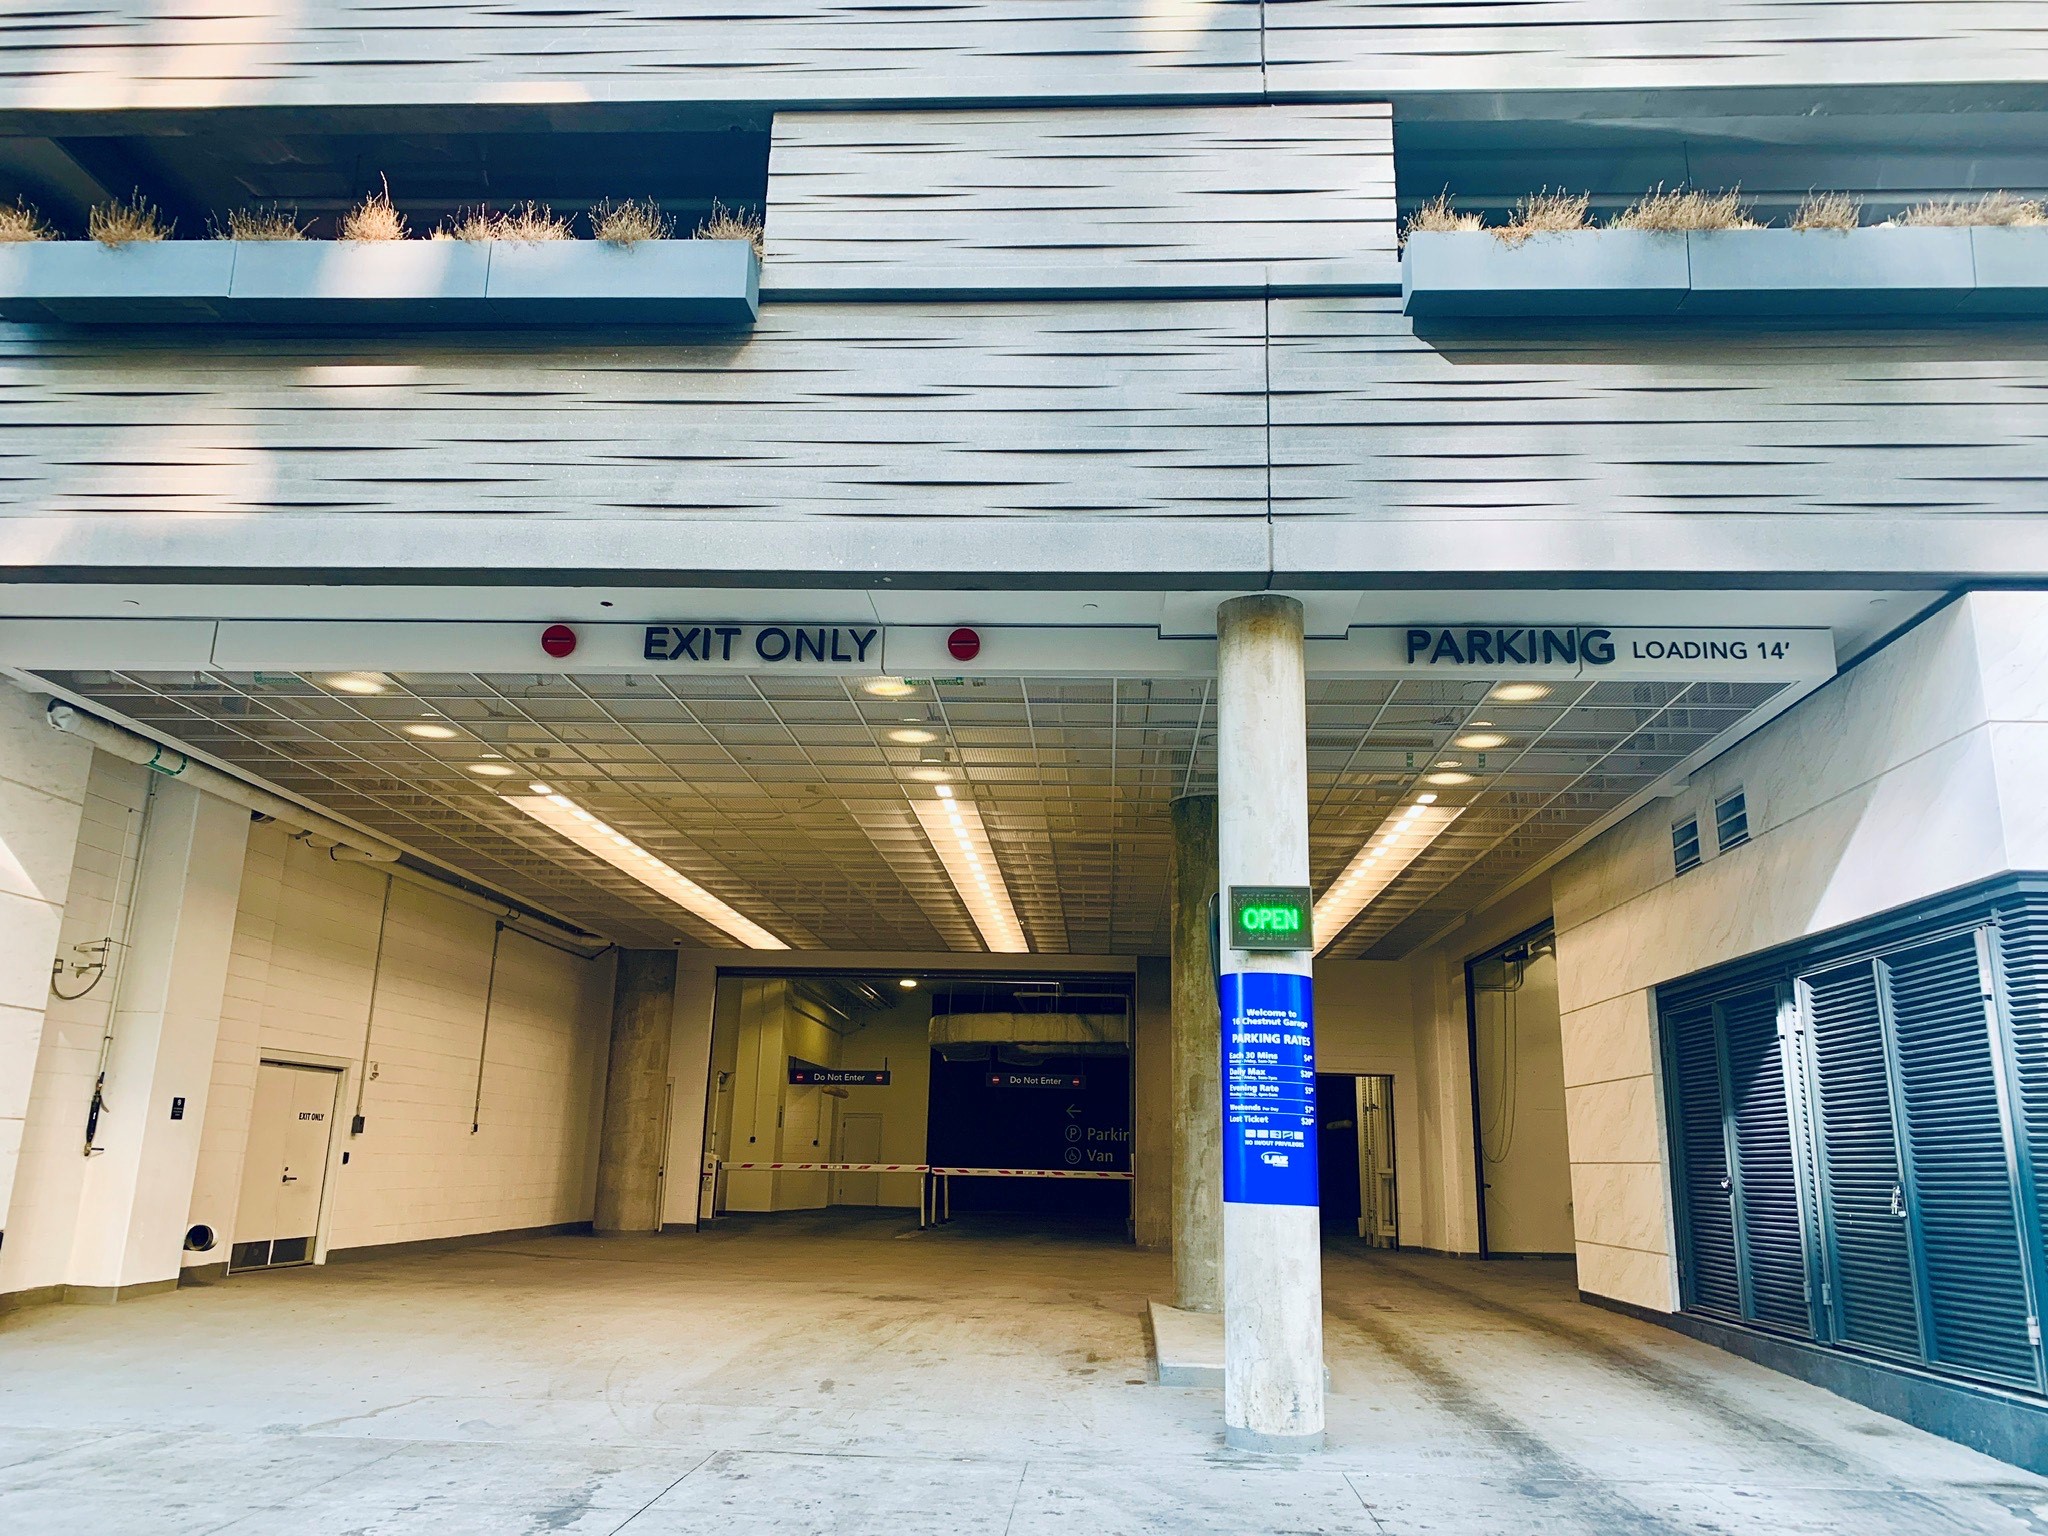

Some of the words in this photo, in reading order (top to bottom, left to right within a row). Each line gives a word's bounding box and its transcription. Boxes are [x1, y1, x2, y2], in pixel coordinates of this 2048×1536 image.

[643, 626, 742, 661] EXIT
[755, 627, 877, 662] ONLY
[1407, 629, 1616, 665] PARKING
[1632, 641, 1748, 660] LOADING
[1242, 907, 1298, 930] OPEN
[1246, 1008, 1287, 1018] Welcome
[1288, 1010, 1297, 1018] to
[1241, 1017, 1281, 1026] Chestnut
[1283, 1019, 1308, 1030] Garage
[1232, 1033, 1281, 1044] PARKING
[1283, 1034, 1311, 1046] RATES
[1229, 1052, 1244, 1060] Each
[1246, 1052, 1255, 1060] 30
[1257, 1052, 1278, 1060] Mins
[814, 1073, 825, 1081] Do
[827, 1073, 842, 1081] Not
[844, 1073, 865, 1081] Enter
[1229, 1068, 1246, 1077] Daily
[1248, 1068, 1265, 1076] Max
[1010, 1076, 1021, 1084] Do
[1024, 1077, 1038, 1085] Not
[1040, 1077, 1061, 1085] Enter
[1230, 1084, 1257, 1093] Evening
[1259, 1084, 1279, 1092] Rate
[299, 1112, 311, 1120] EXIT
[311, 1113, 324, 1121] ONLY
[1230, 1115, 1242, 1123] Lost
[1244, 1115, 1269, 1123] Ticket
[1087, 1149, 1113, 1162] Van
